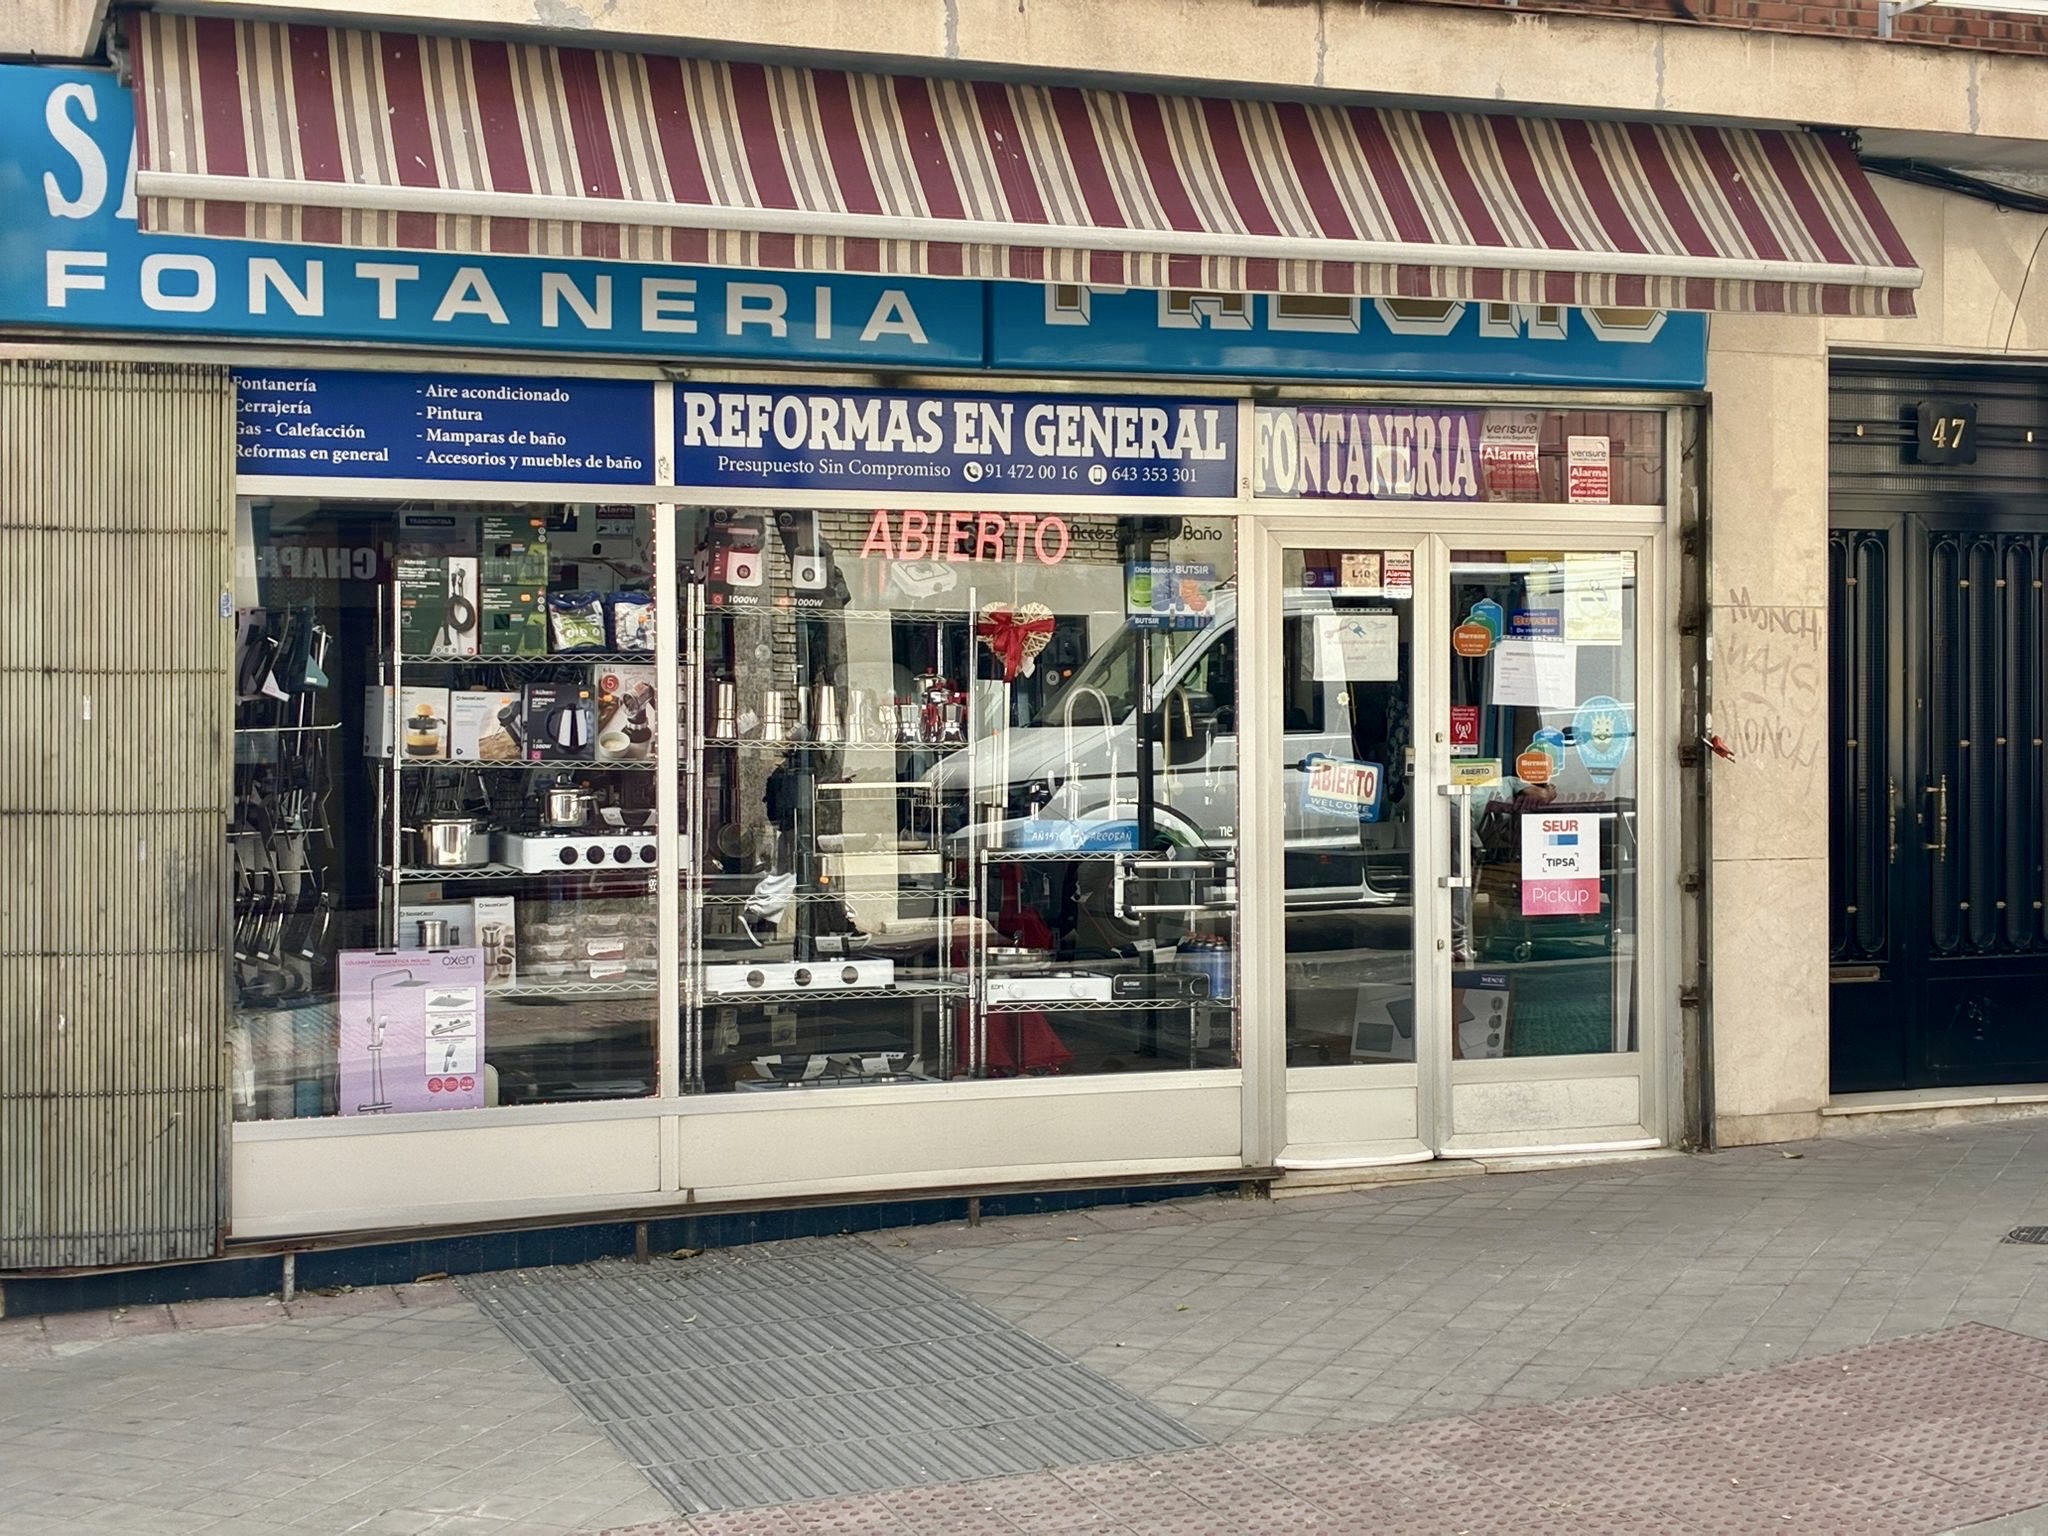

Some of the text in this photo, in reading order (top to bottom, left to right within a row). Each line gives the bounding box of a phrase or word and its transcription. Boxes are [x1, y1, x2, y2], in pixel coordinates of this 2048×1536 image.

[46, 249, 929, 345] FONTANERIA
[233, 375, 317, 392] Fontanería
[426, 384, 570, 403] Aire acondicionado
[236, 398, 312, 417] Cerrajería
[426, 406, 484, 421] Pintura
[236, 421, 366, 439] Gas Calefacción
[683, 391, 1227, 461] REFORMAS EN GENERAL
[1486, 424, 1537, 434] verisure
[1931, 417, 1966, 449] 47
[426, 428, 567, 447] Mamparas de baño
[236, 444, 390, 464] Reformas en general
[426, 450, 642, 470] Accesorios y muebles de baño
[1254, 412, 1478, 497] FONTANERIA
[1484, 446, 1535, 460] Alarma
[1570, 450, 1607, 458] verisure
[718, 455, 952, 480] Presupuesto Sin Compromiso
[985, 463, 1079, 480] 91 472 00 16
[1111, 466, 1198, 483] 643 353 301
[1571, 467, 1608, 477] Alarma
[860, 509, 1069, 565] ABIERTO
[1175, 565, 1209, 575] BUTSIR
[728, 595, 758, 605] 1000W
[1460, 767, 1490, 776] ABIERTO
[1310, 765, 1375, 798] ABIERTO
[1310, 797, 1370, 813] WELCOME
[1542, 819, 1579, 832] SEUR
[1546, 857, 1576, 867] TIPSA
[1532, 886, 1590, 906] Pickup
[441, 954, 475, 966] oxen
